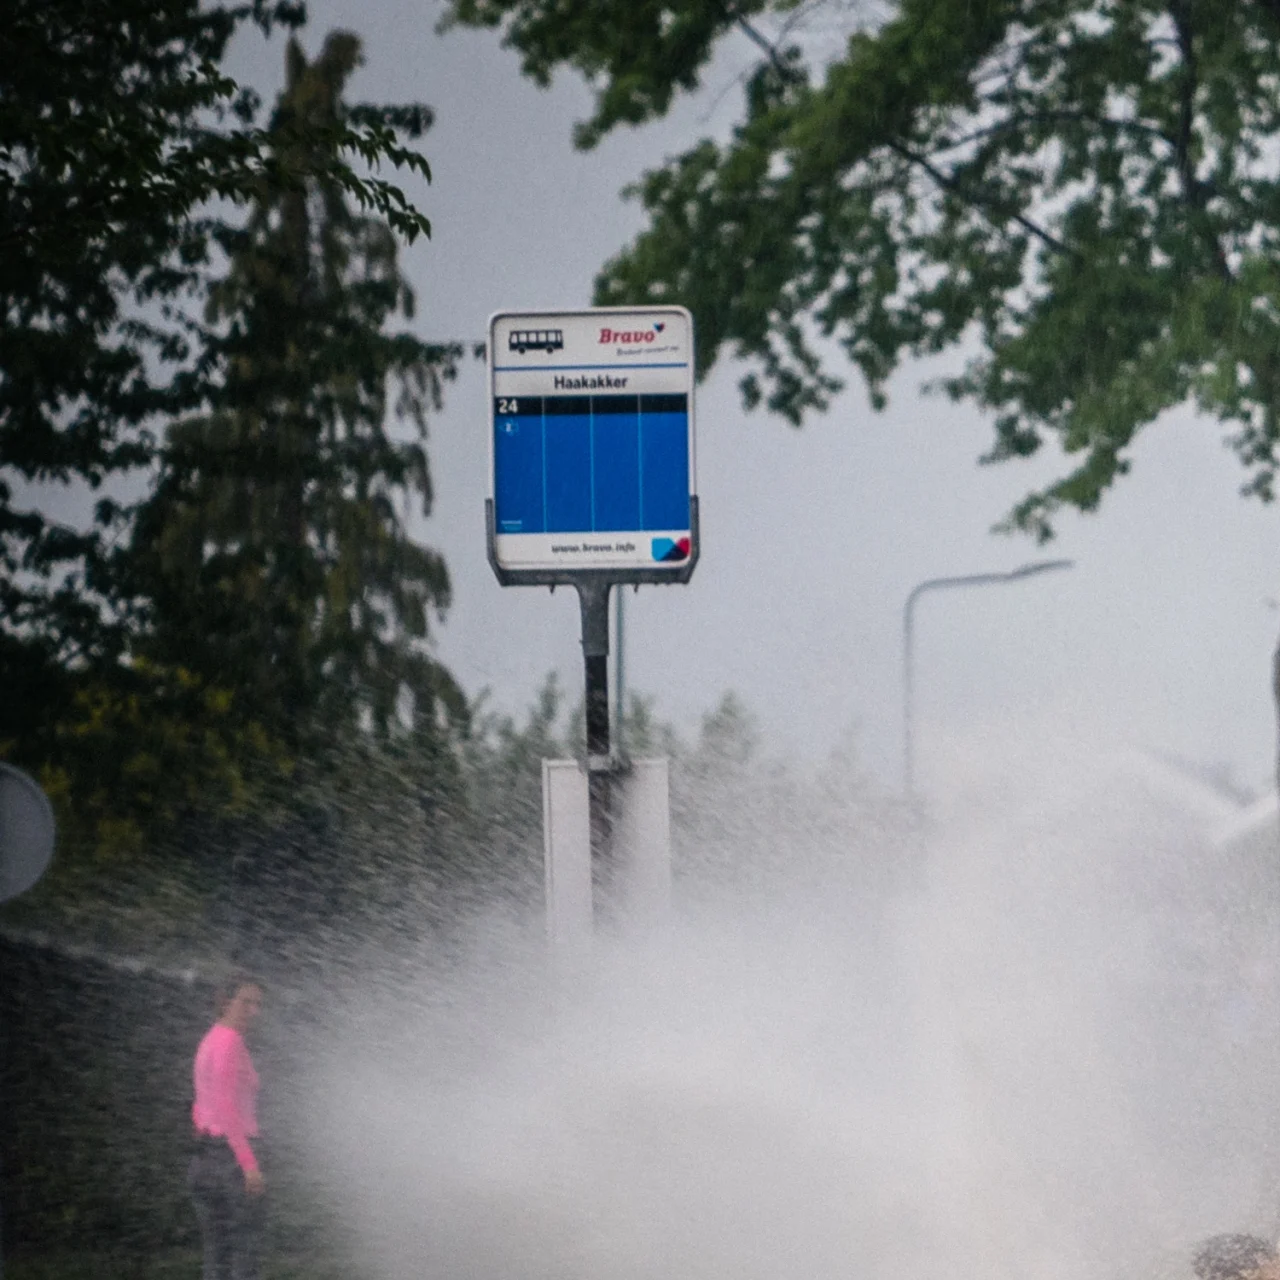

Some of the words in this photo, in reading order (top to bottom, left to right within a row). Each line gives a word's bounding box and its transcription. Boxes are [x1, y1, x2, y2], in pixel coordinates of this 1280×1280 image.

[598, 328, 655, 343] Bravo
[554, 375, 628, 389] Haakakker
[499, 399, 518, 413] 24
